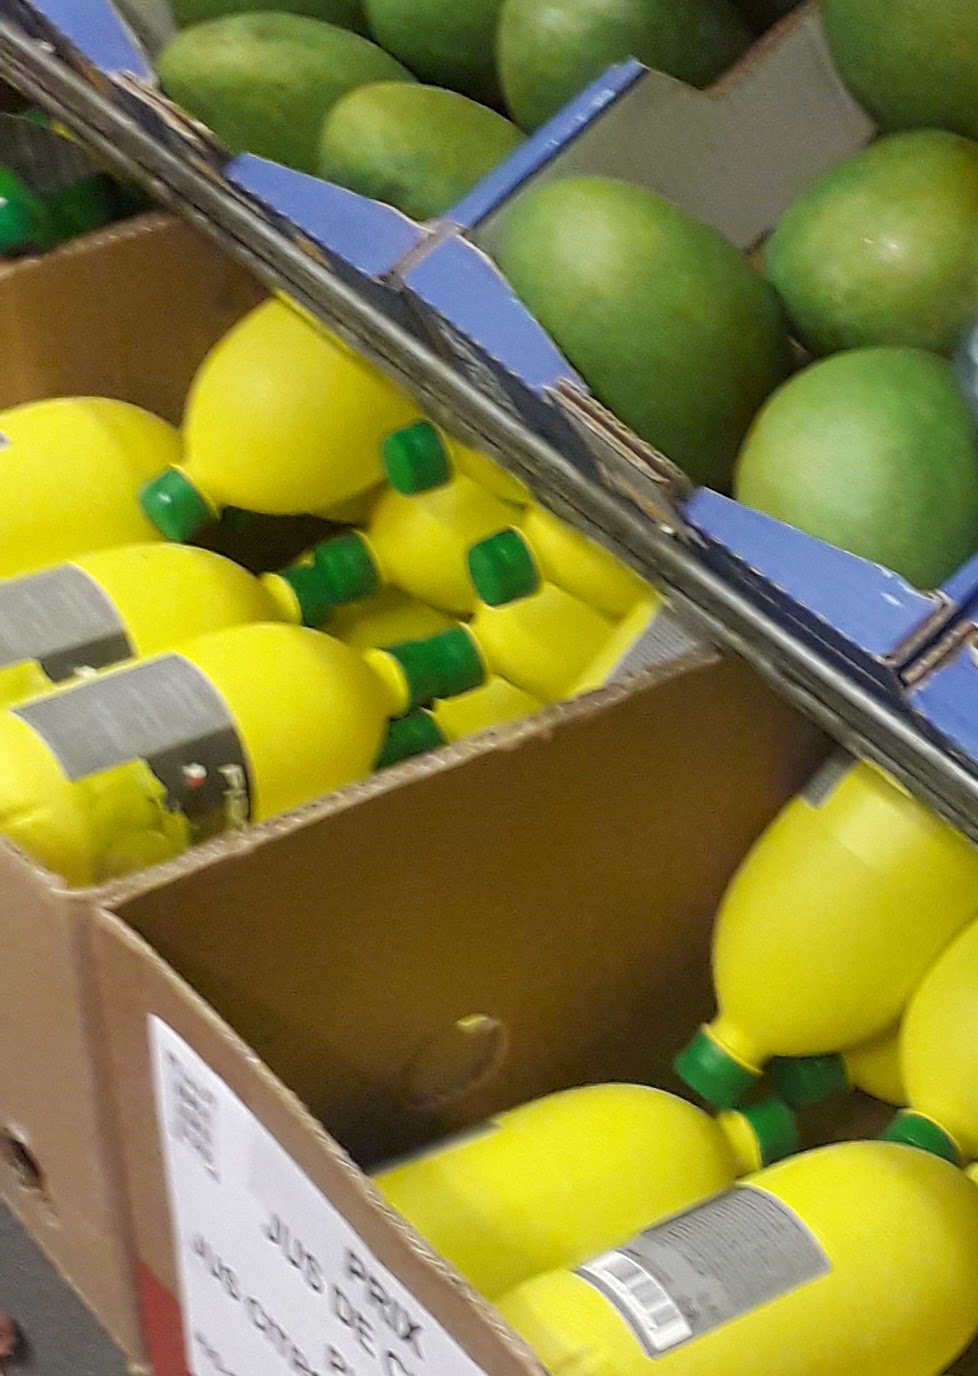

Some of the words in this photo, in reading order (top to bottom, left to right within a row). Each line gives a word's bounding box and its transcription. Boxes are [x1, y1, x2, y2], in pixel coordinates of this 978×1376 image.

[193, 1234, 241, 1303] JUS
[263, 1214, 325, 1294] JUS
[331, 1284, 377, 1359] DE
[344, 1248, 424, 1360] PRIX
